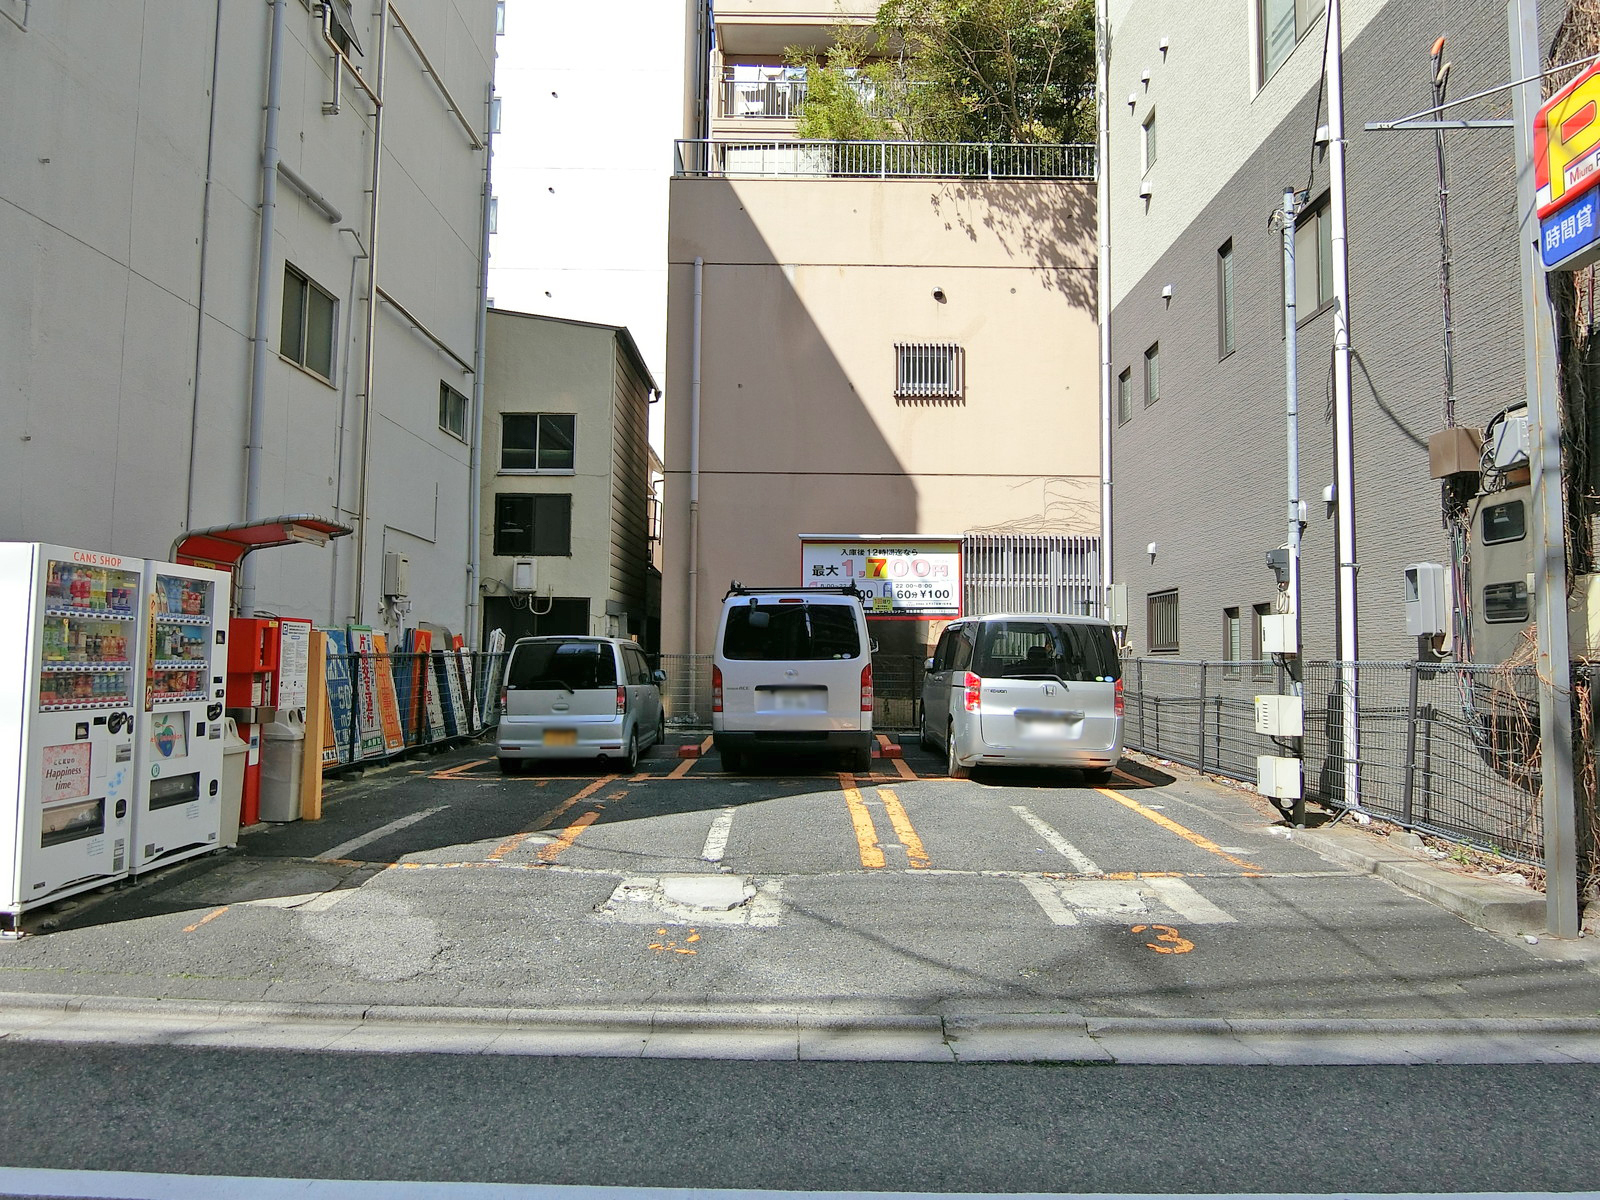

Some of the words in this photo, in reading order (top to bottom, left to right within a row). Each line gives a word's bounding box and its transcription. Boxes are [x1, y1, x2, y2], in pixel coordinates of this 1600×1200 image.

[1570, 163, 1594, 185] Miura
[1545, 204, 1593, 251] 時間貸
[73, 551, 97, 564] CANS
[99, 554, 122, 568] SHOP
[812, 564, 839, 577] 最大
[841, 558, 949, 579] 1,700円
[920, 590, 950, 599] ¥100
[45, 766, 82, 780] Happiness
[55, 781, 72, 790] time
